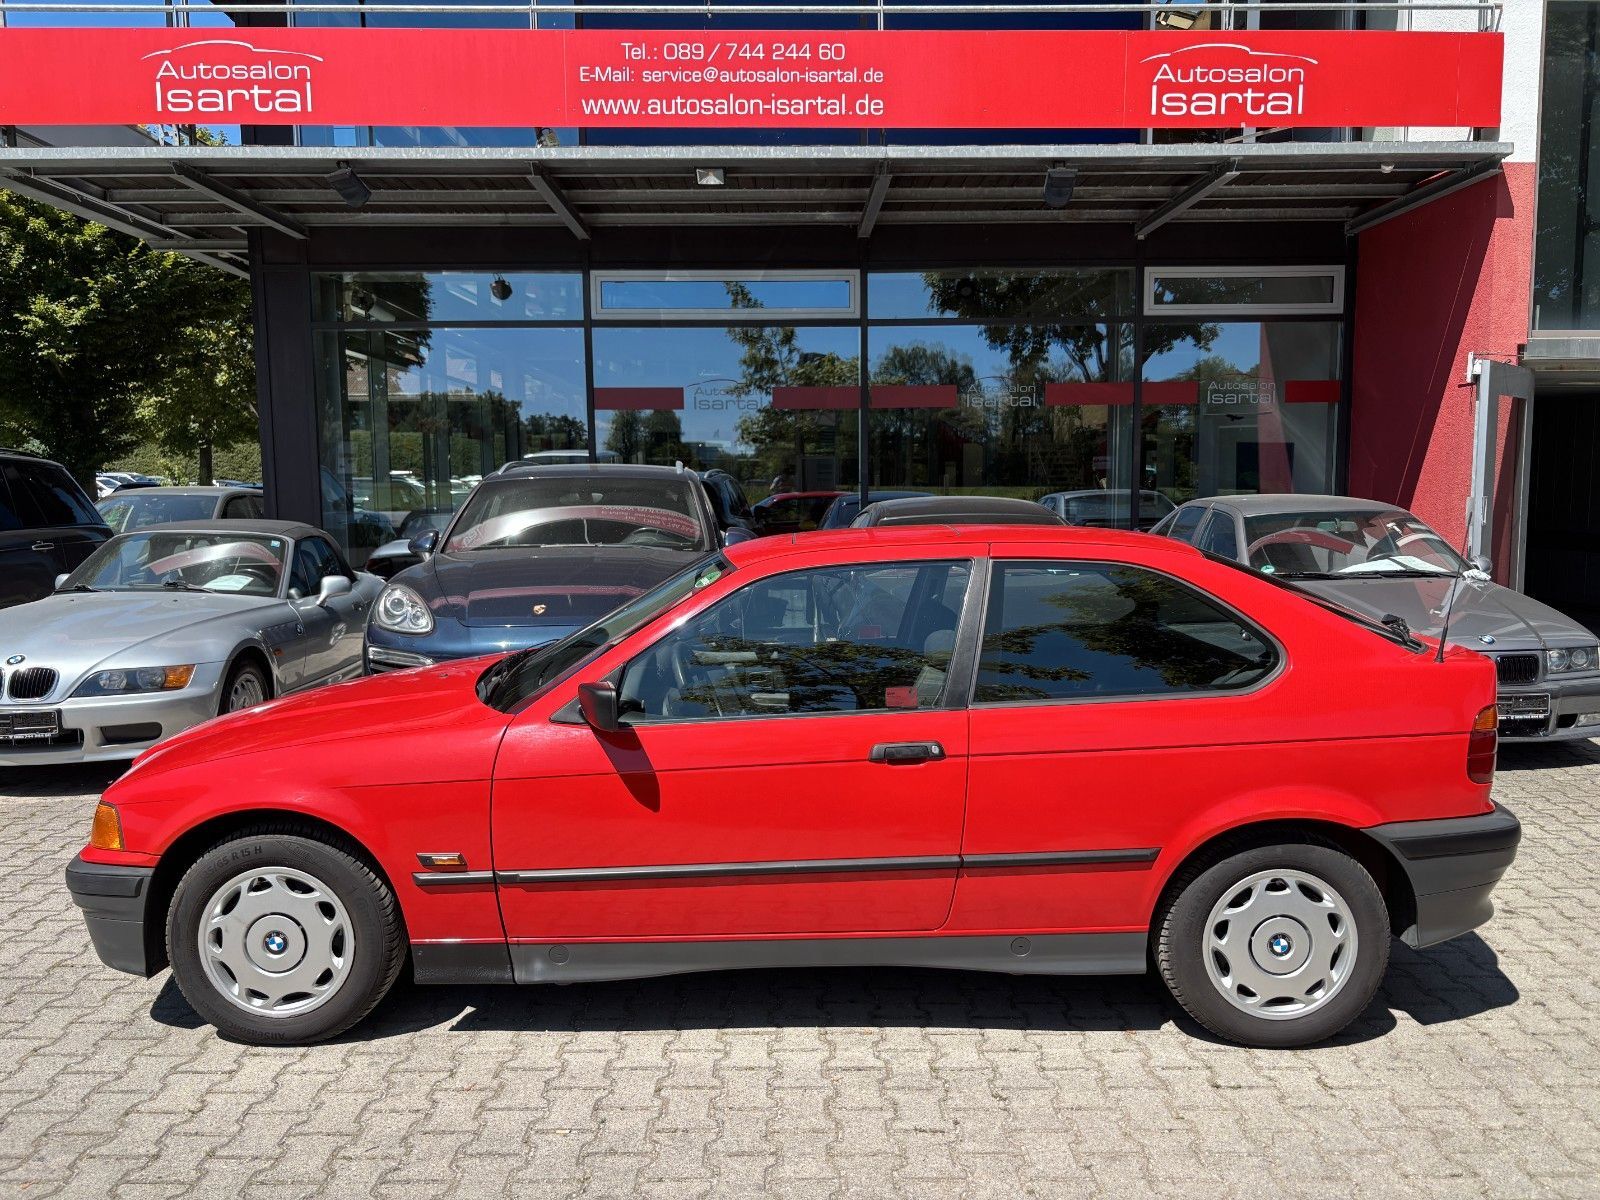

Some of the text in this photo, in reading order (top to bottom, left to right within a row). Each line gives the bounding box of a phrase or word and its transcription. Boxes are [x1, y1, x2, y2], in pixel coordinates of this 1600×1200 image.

[621, 42, 846, 62] Tel.: 089 / 744 244 60
[156, 60, 311, 80] Autosalon
[579, 66, 884, 83] E-Mail: service@autosalon-isartal.de
[1152, 63, 1304, 83] Autosalon
[155, 81, 313, 113] Isartal
[581, 93, 884, 115] www.autosalon-isartal.de
[1151, 84, 1304, 115] Isartal
[1208, 381, 1276, 390] Autosalon
[693, 396, 763, 410] Isartal
[1207, 390, 1276, 404] Isartal
